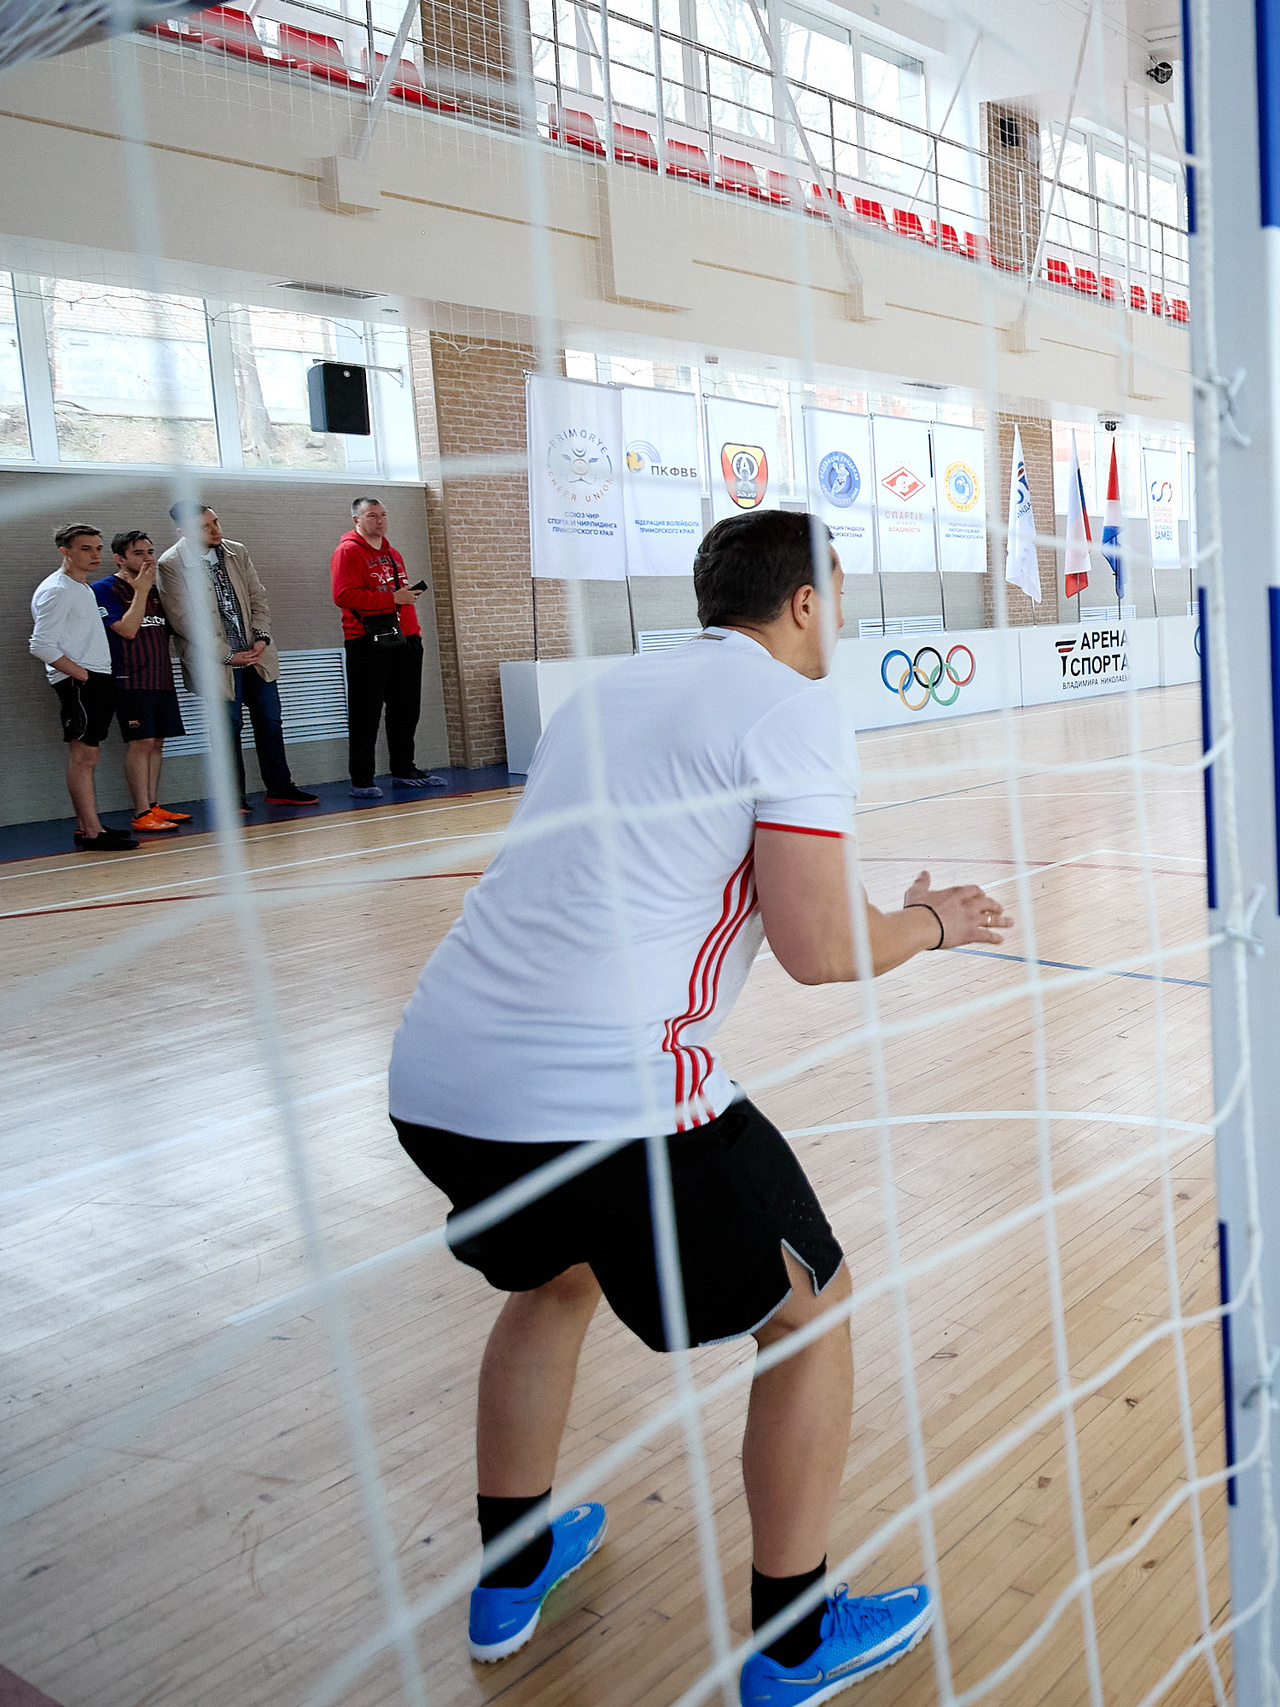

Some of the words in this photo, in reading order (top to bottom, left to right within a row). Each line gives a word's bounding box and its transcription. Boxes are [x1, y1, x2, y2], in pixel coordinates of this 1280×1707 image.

[651, 465, 697, 478] ПКФВБ
[1080, 629, 1129, 650] АРЕНА
[1070, 653, 1130, 677] СПОРТА
[1062, 679, 1099, 690] ВЛАДИМИРА
[1100, 674, 1131, 685] НИКОЛАЕВ
